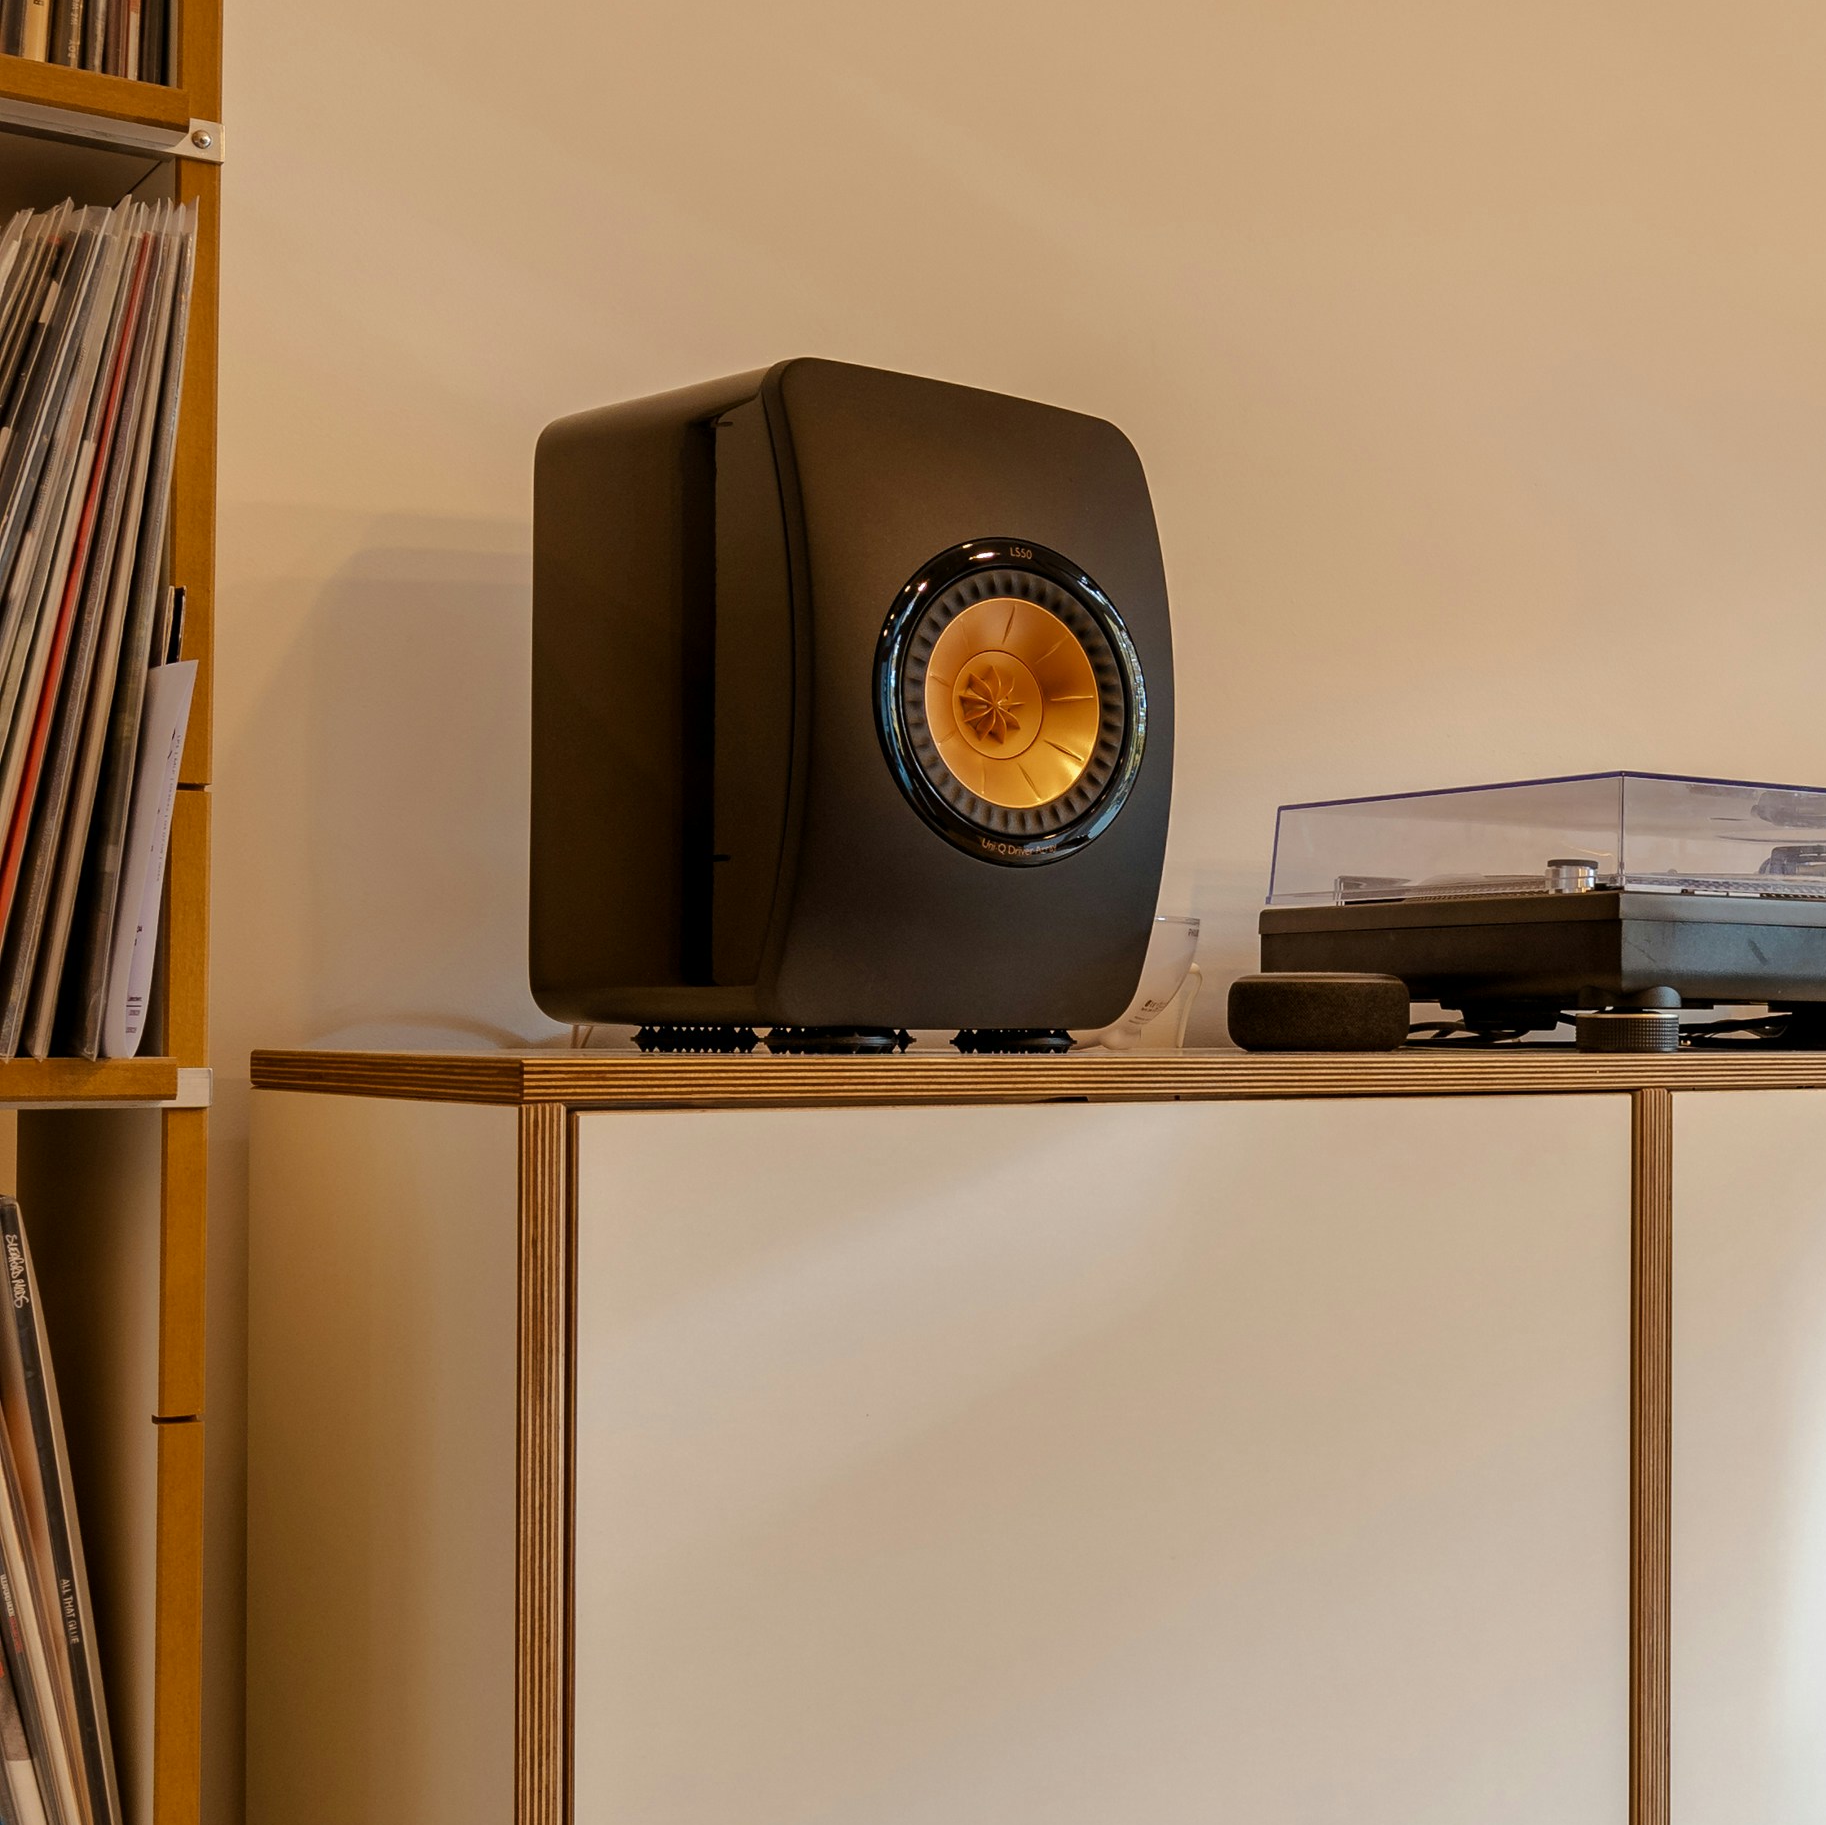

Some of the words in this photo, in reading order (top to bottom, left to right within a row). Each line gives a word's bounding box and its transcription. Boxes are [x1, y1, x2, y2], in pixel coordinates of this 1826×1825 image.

[1009, 546, 1033, 560] LS50
[1007, 845, 1033, 856] Driver
[61, 1578, 71, 1594] ALL
[62, 1595, 74, 1619] THAT
[66, 1619, 79, 1644] GLUE
